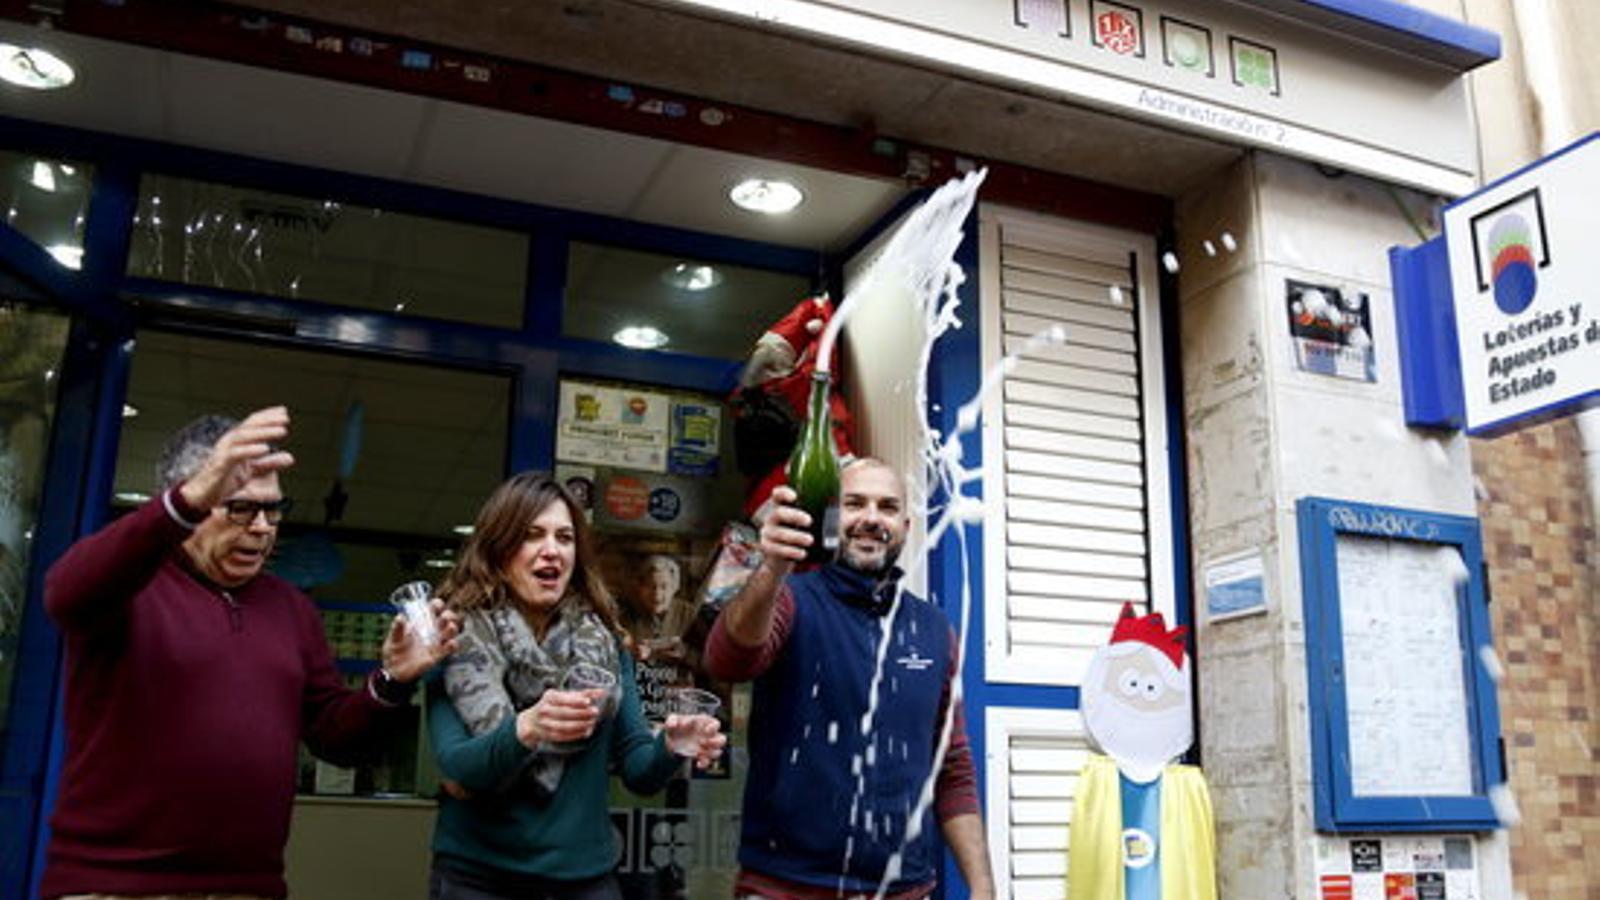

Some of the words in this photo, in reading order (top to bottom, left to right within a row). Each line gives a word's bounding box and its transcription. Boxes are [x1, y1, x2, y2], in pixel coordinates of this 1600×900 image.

[1569, 302, 1582, 326] y
[1488, 333, 1579, 378] Apuestas
[1585, 318, 1600, 344] d
[1488, 367, 1556, 404] Estado
